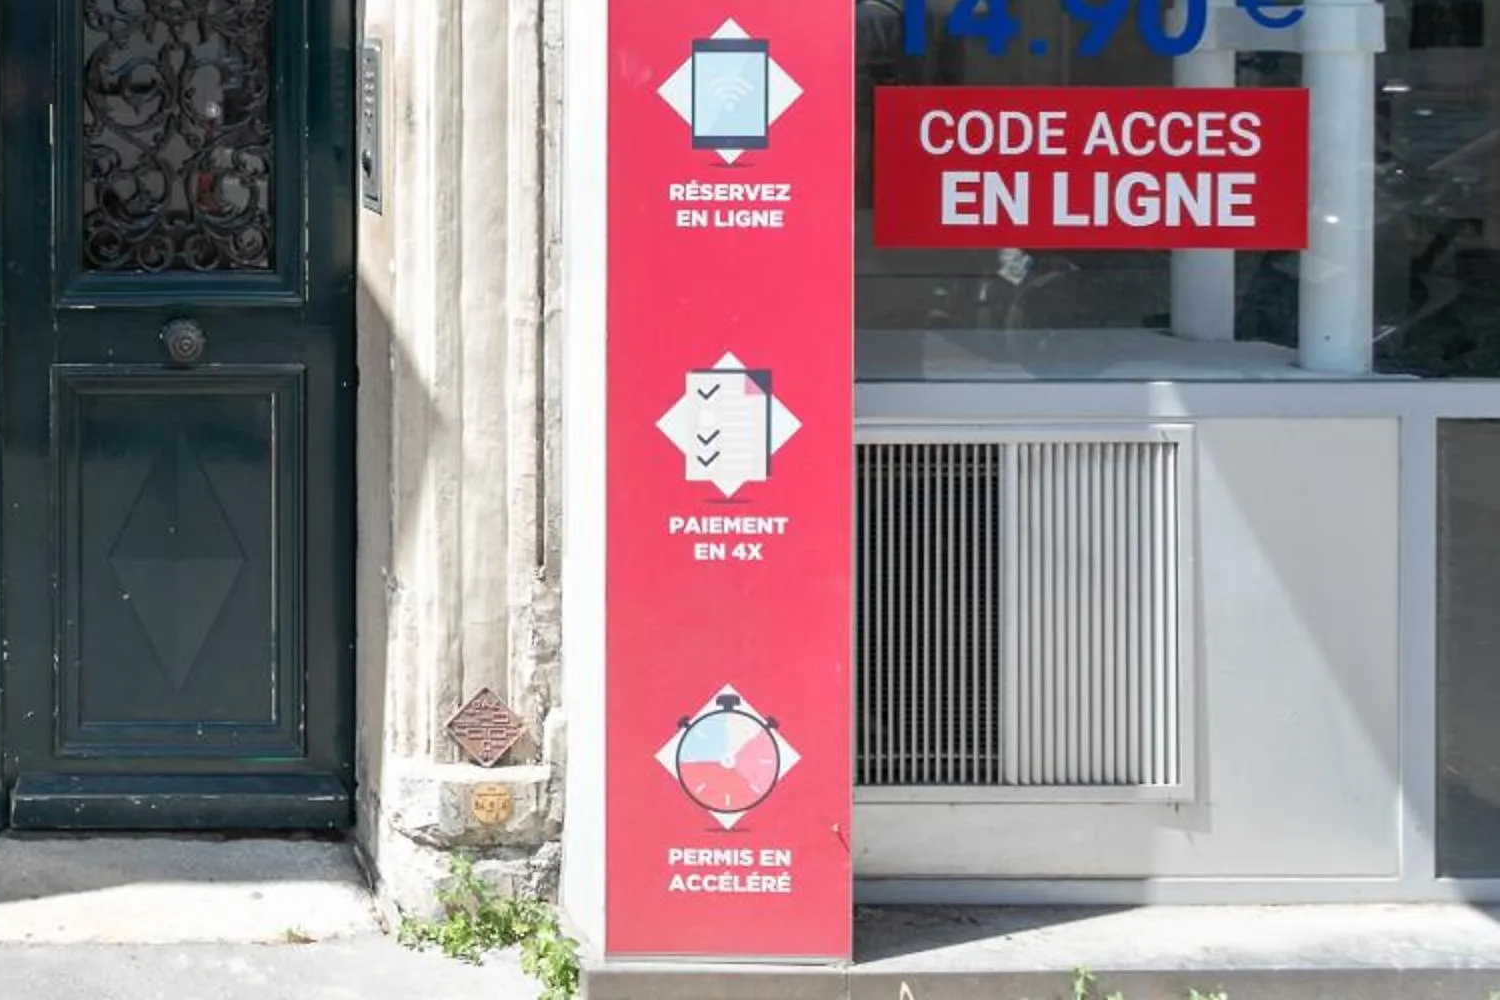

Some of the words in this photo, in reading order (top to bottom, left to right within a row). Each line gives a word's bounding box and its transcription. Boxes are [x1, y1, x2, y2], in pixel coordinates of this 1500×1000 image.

[920, 110, 1067, 156] CODE
[1083, 111, 1261, 157] ACCES
[669, 181, 790, 201] RÉSERVEZ
[941, 171, 1029, 225] EN
[1053, 171, 1256, 227] LIGNE
[676, 210, 708, 227] EN
[714, 210, 783, 227] LIGNE
[669, 516, 788, 534] PAIEMENT
[694, 543, 726, 560] EN
[732, 543, 762, 560] 4X
[669, 848, 753, 866] PERMIS
[760, 849, 791, 866] EN
[668, 872, 791, 892] ACCÉLÉRÉ
